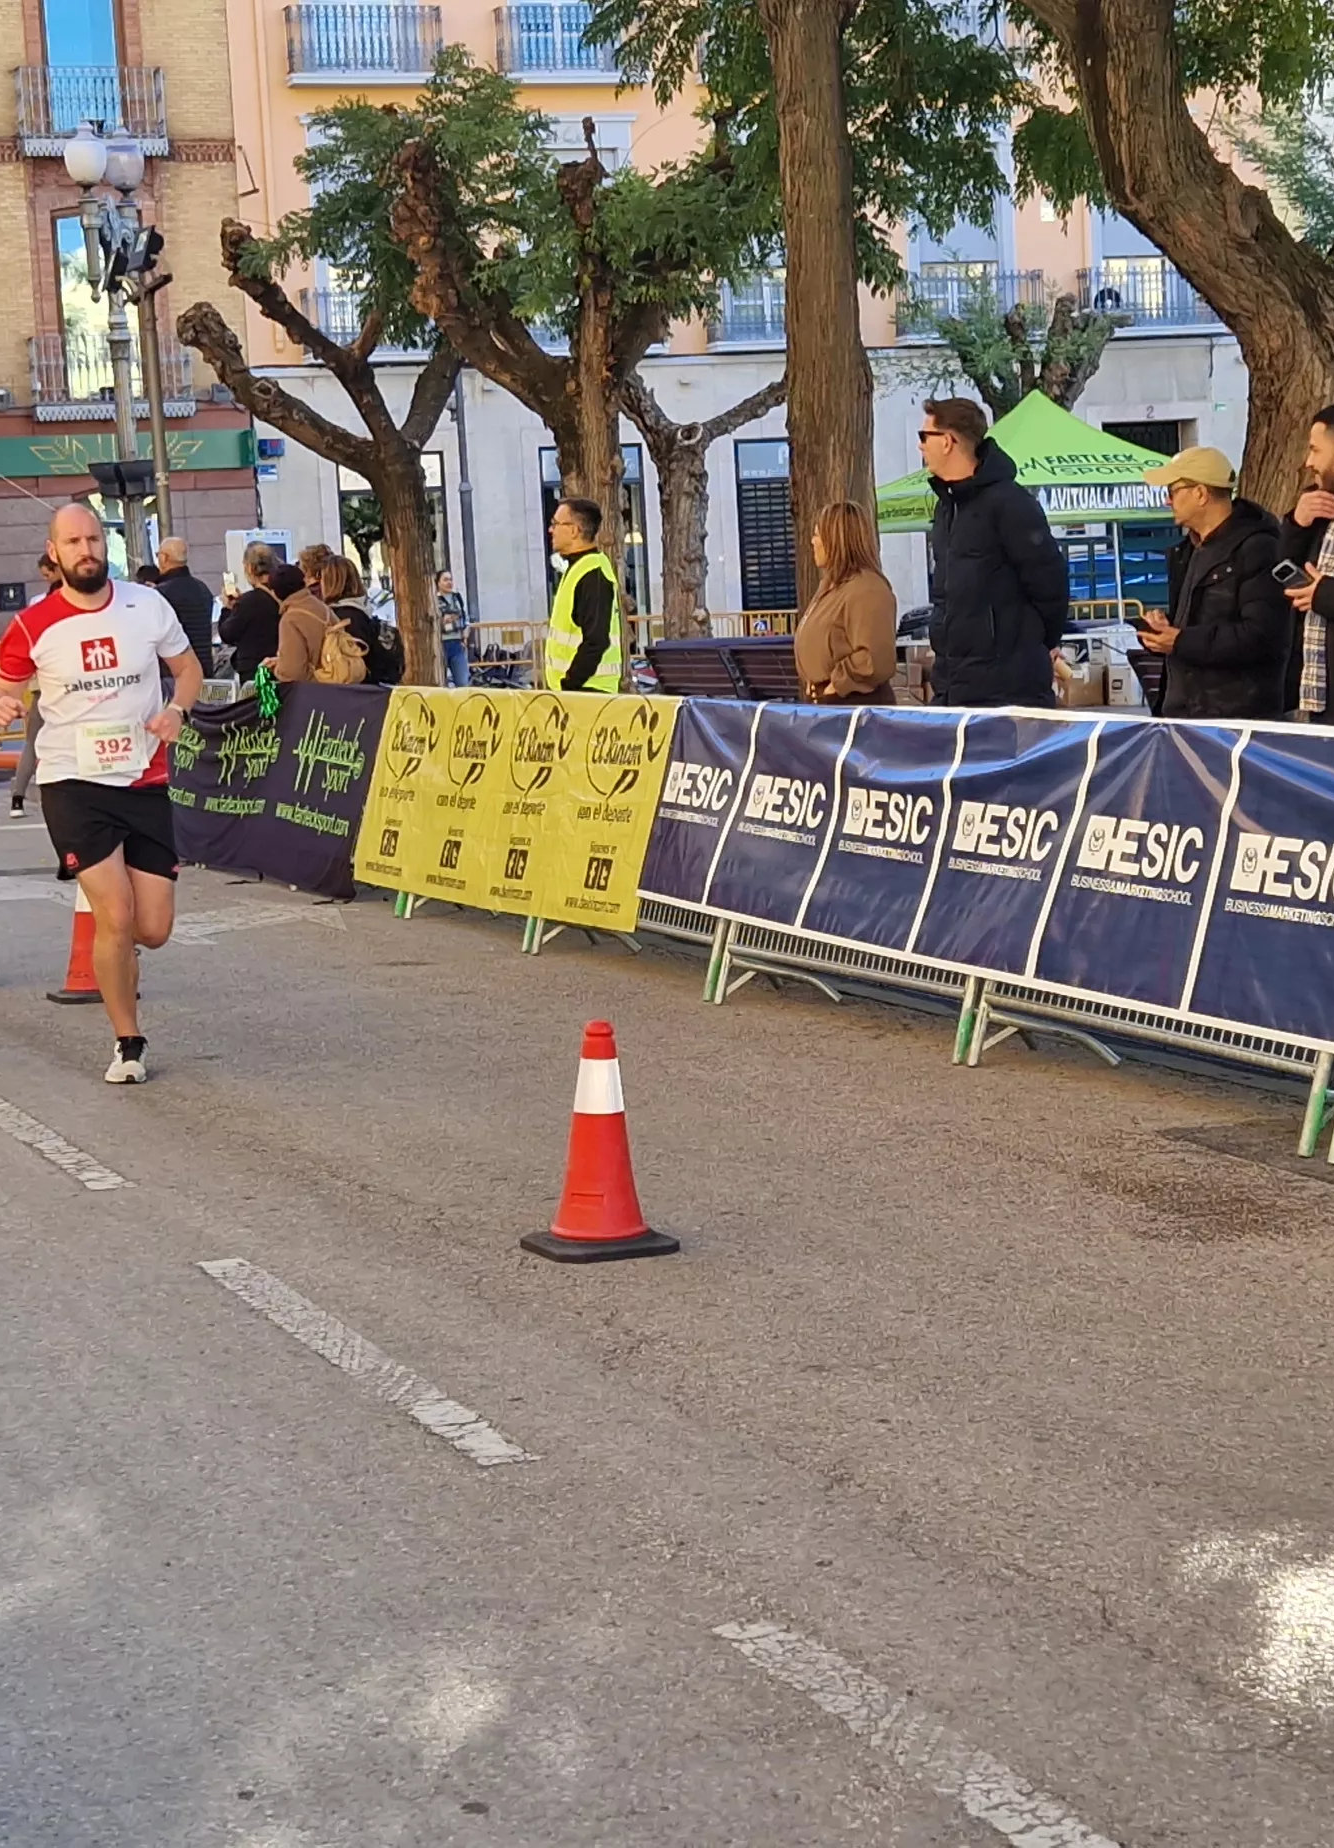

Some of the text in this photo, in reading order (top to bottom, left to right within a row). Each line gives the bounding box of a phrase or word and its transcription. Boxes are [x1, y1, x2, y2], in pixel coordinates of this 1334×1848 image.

[1146, 405, 1155, 419] 2
[1045, 453, 1139, 465] FARTLECK
[1059, 465, 1147, 477] SPORT
[1049, 485, 1170, 512] AVITUALLAMIENTO
[63, 674, 142, 695] salesianos
[94, 737, 133, 755] 392
[678, 763, 733, 811] ESIC
[762, 776, 827, 829] ESIC
[864, 790, 934, 845] ESIC
[976, 803, 1058, 862] ESIC
[1108, 819, 1204, 884] ESIC
[1070, 873, 1193, 906] BUSINESS&MARKETINGSCHOOL
